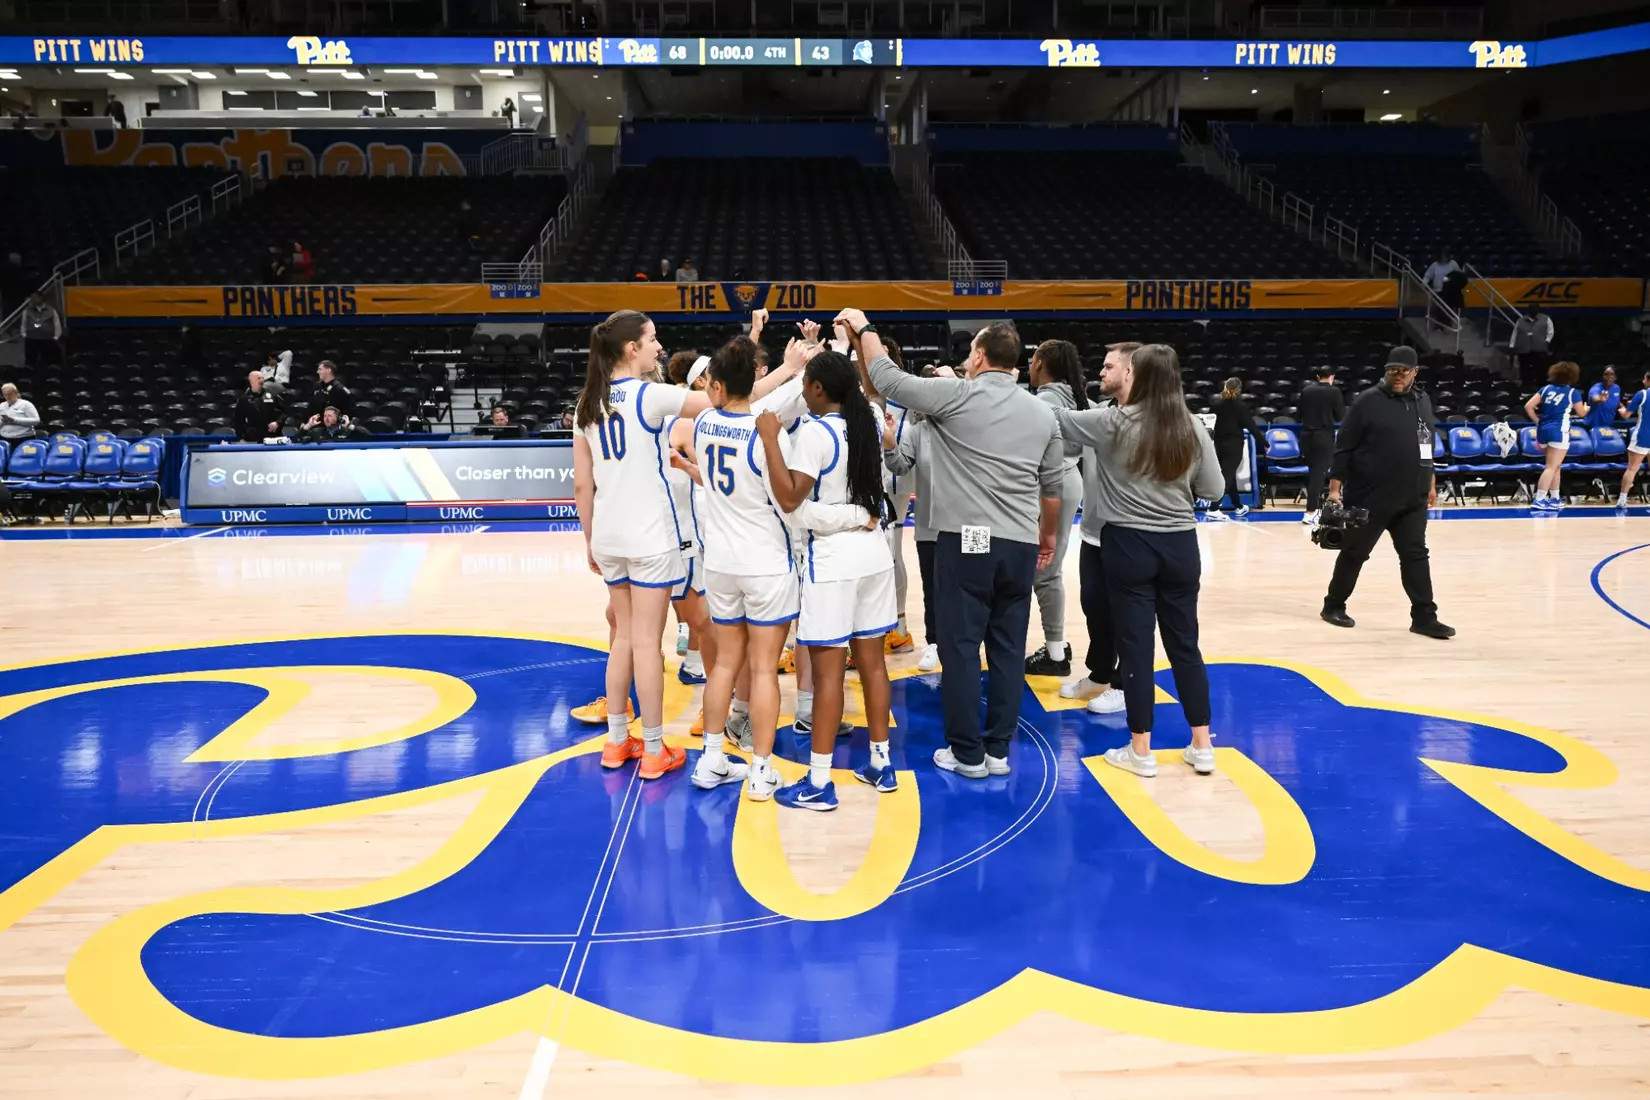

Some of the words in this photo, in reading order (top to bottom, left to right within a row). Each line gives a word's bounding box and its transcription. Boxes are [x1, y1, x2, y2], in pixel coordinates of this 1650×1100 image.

[33, 39, 81, 61] PITT
[89, 39, 144, 61] WINS
[287, 36, 353, 64] Pitt
[494, 40, 540, 62] PITT
[548, 40, 601, 62] WINS
[618, 38, 658, 63] Pitt
[669, 46, 687, 60] 68
[710, 46, 754, 60] 0:00.0
[764, 47, 786, 58] 4TH
[812, 46, 830, 60] 43
[1040, 39, 1101, 66] Pitt
[1235, 43, 1280, 64] PITT
[1287, 43, 1336, 65] WINS
[1468, 41, 1527, 67] Pitt
[224, 286, 357, 317] PANTHERS
[677, 284, 717, 309] THE
[776, 284, 817, 309] ZOO
[1127, 280, 1251, 311] PANTHERS
[1520, 282, 1584, 300] ACC
[1544, 391, 1566, 407] 24
[598, 410, 627, 461] 10
[232, 469, 337, 486] Clearview
[456, 466, 512, 480] Closer
[515, 465, 555, 480] than
[704, 443, 738, 497] 15
[221, 510, 267, 522] UPMC
[327, 508, 372, 520] UPMC
[439, 507, 484, 519] UPMC
[547, 505, 580, 518] UPM
